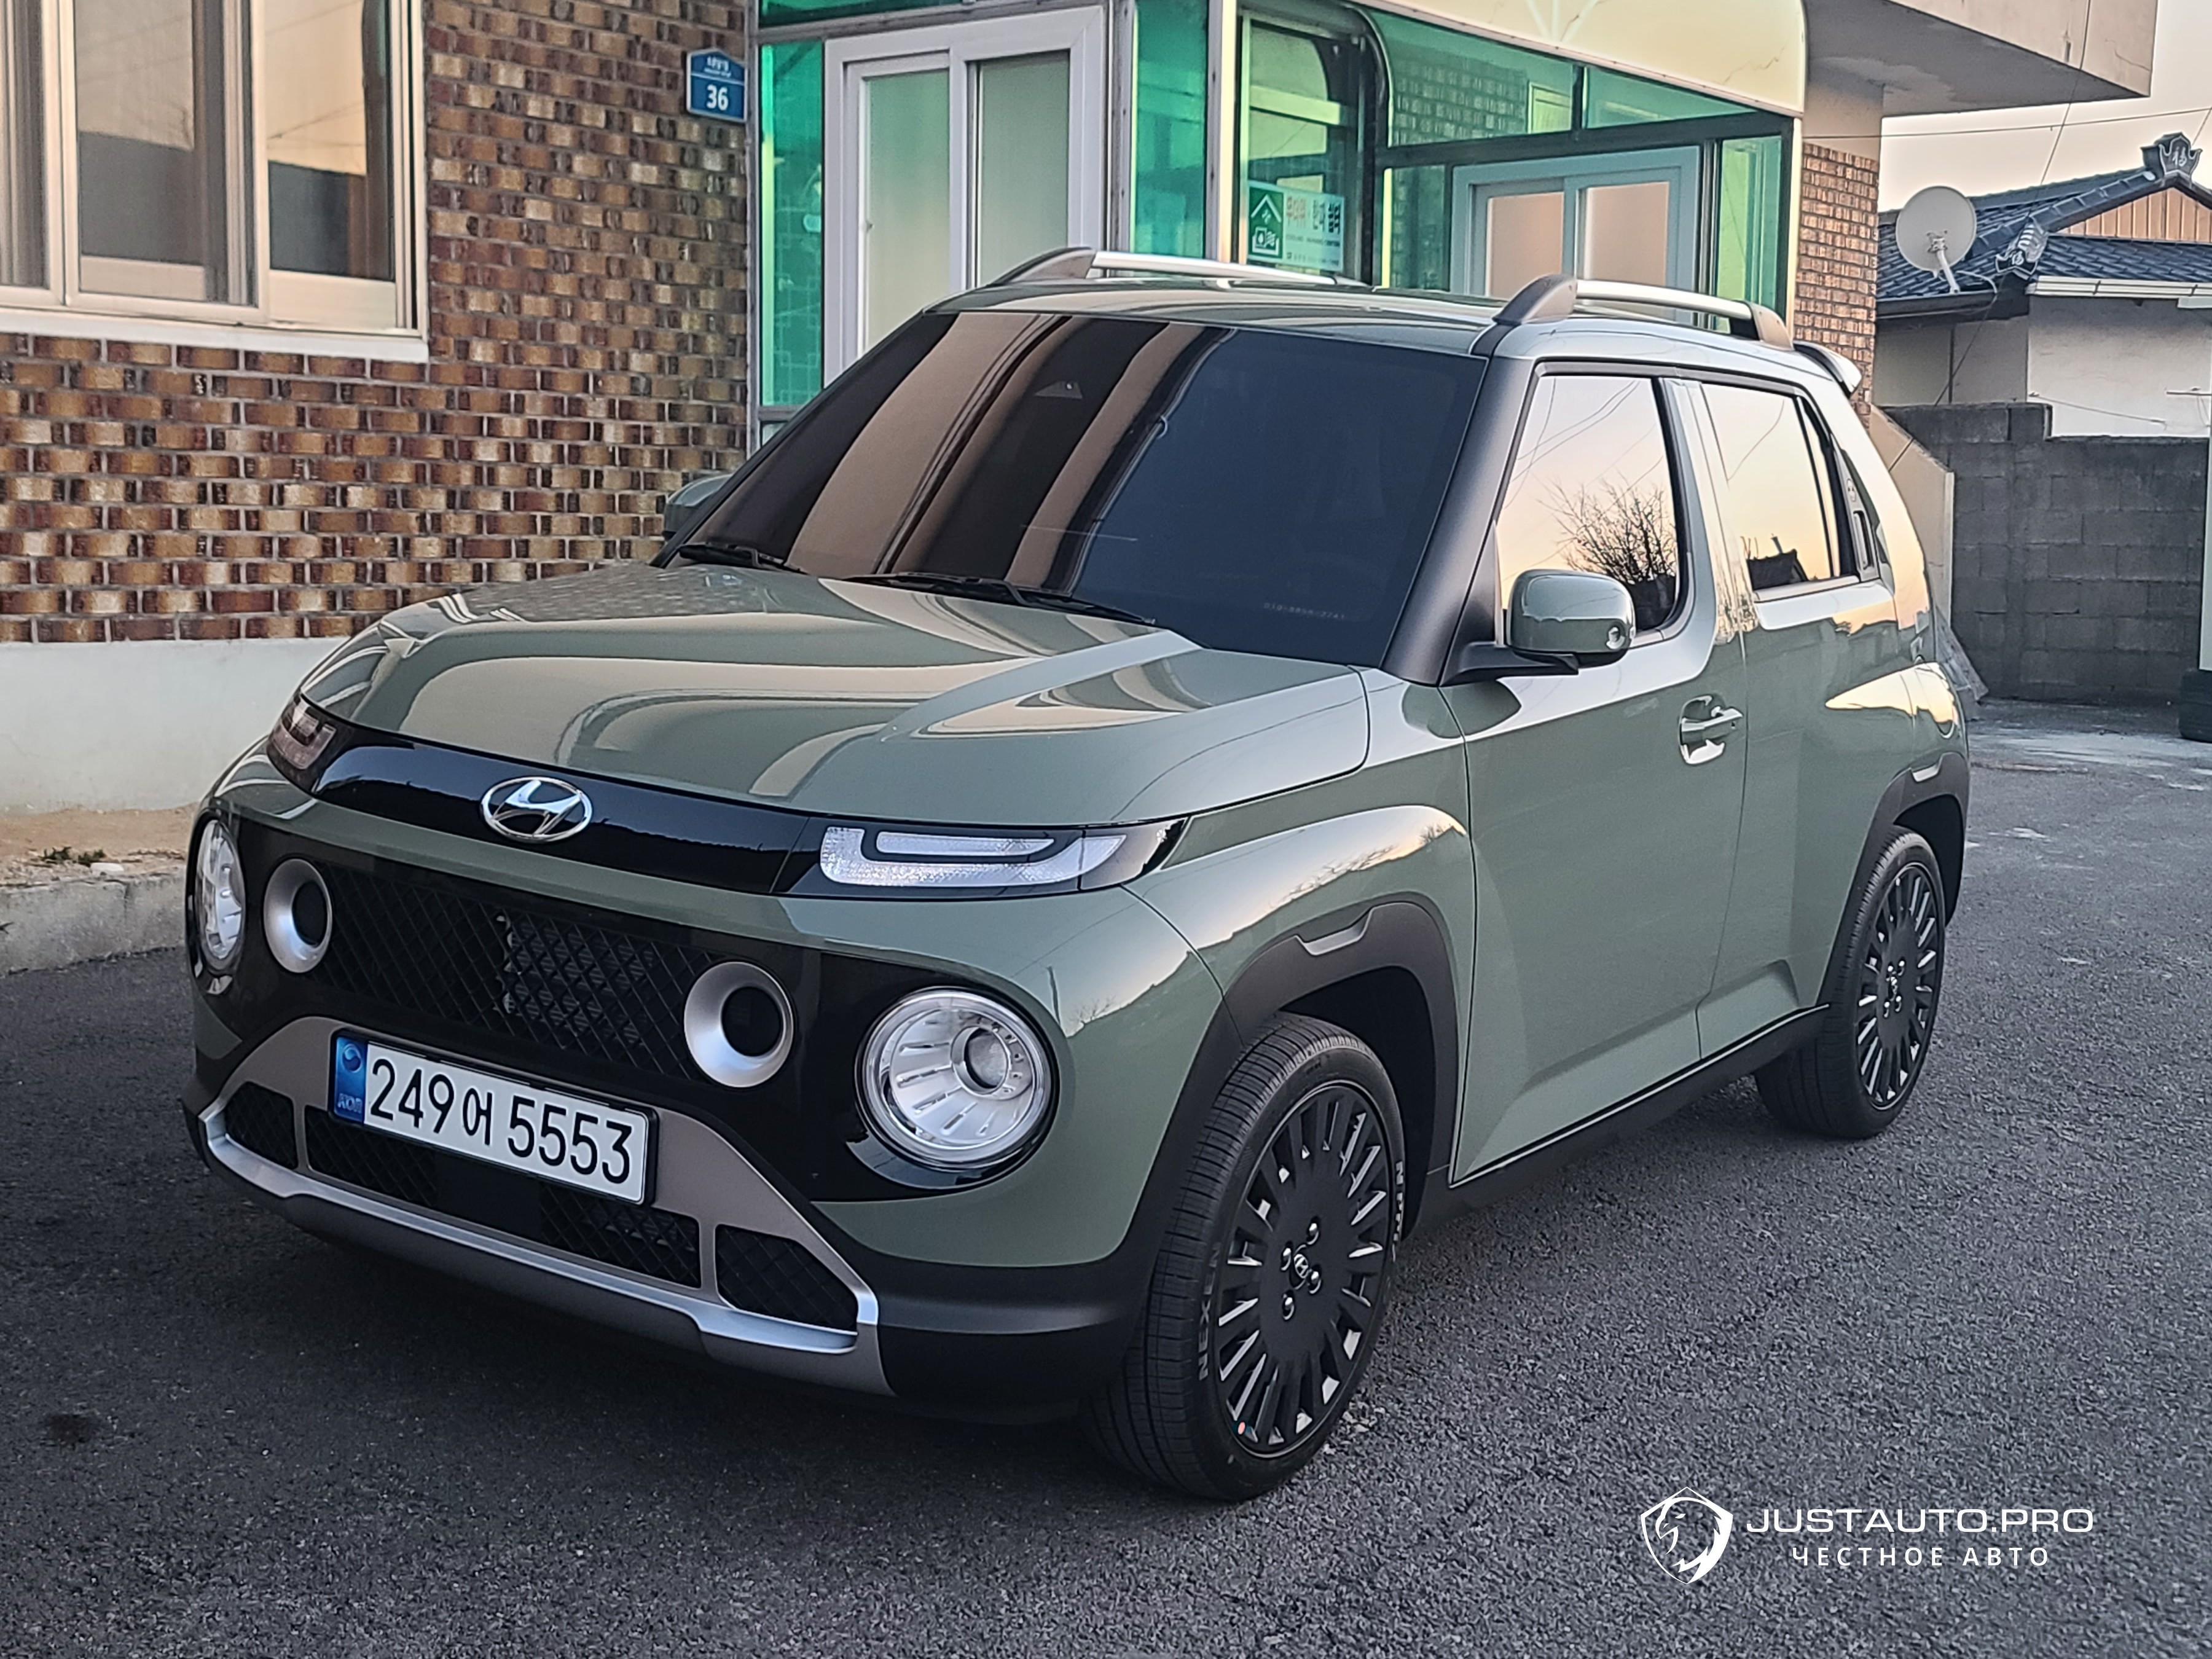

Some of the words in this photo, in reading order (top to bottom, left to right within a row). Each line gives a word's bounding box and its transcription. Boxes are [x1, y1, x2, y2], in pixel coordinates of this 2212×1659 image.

[707, 84, 729, 111] 36
[370, 1058, 492, 1146] 249어
[508, 1095, 633, 1184] 5553
[1199, 1241, 1222, 1381] NEXEN
